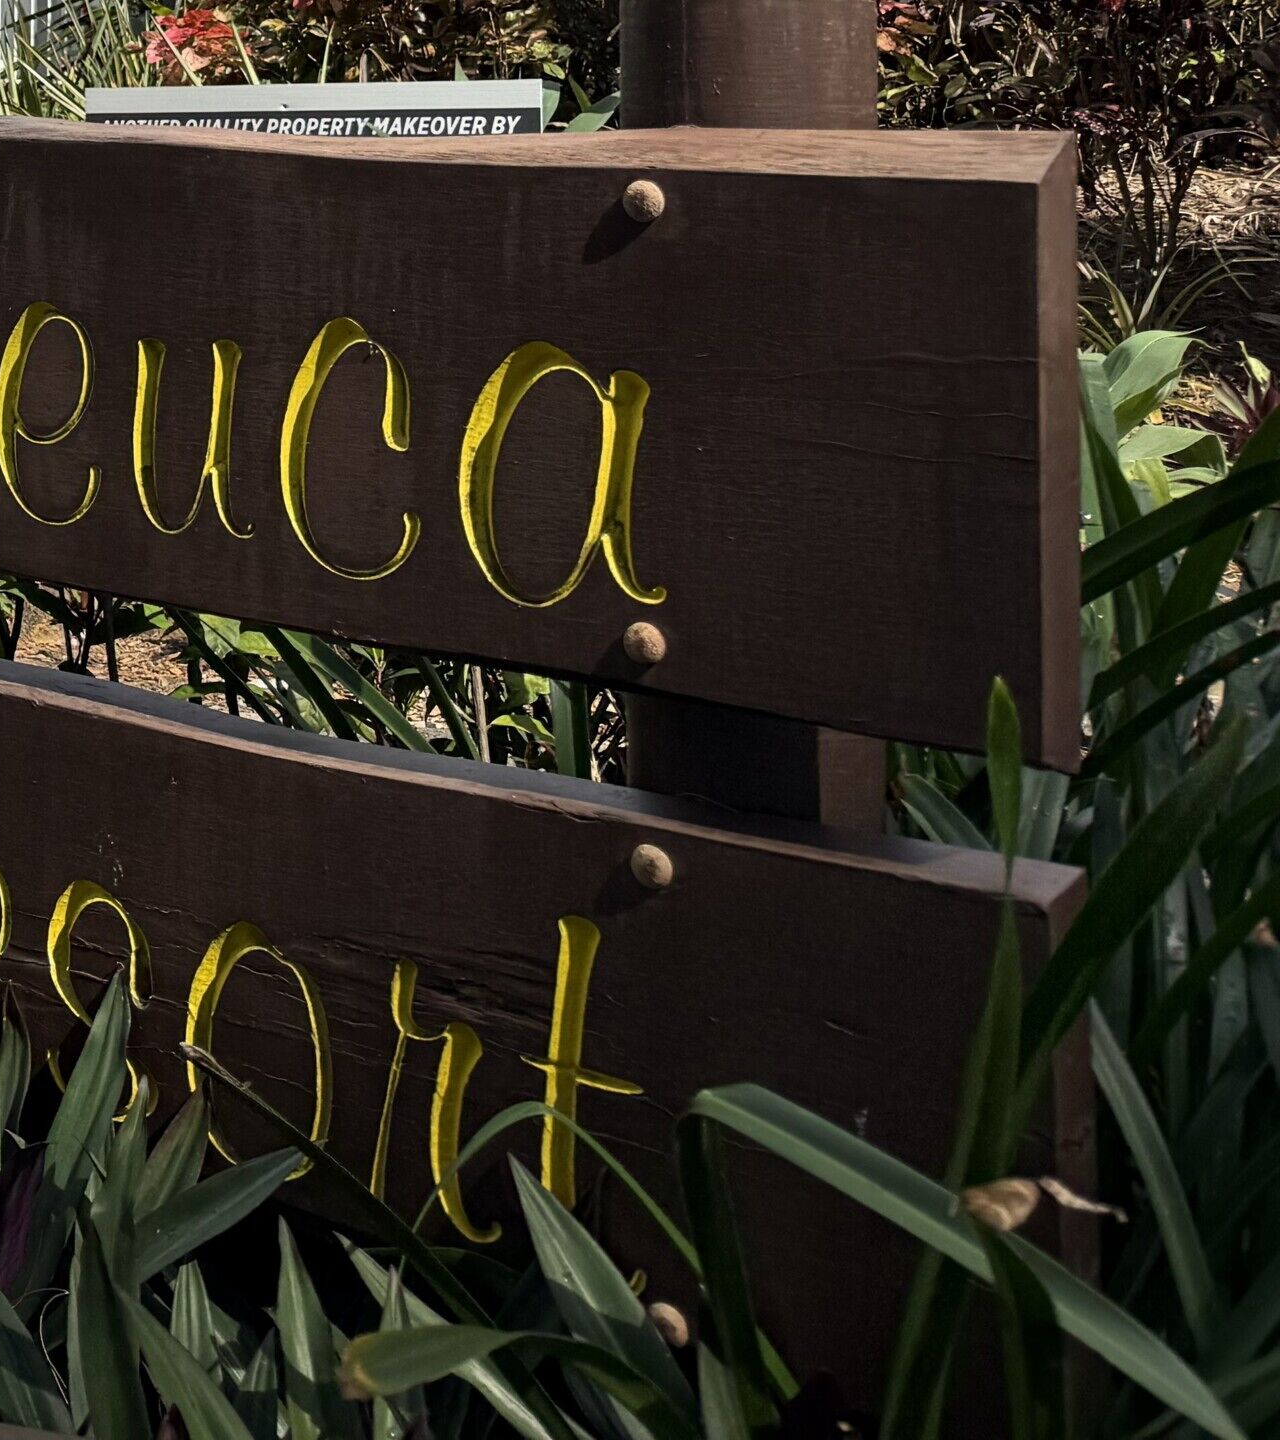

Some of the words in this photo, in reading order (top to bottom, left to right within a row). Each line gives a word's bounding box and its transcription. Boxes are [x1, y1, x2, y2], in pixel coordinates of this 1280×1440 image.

[266, 116, 370, 136] PROPERTY
[371, 115, 486, 136] MAKEOVER
[491, 115, 522, 135] BY
